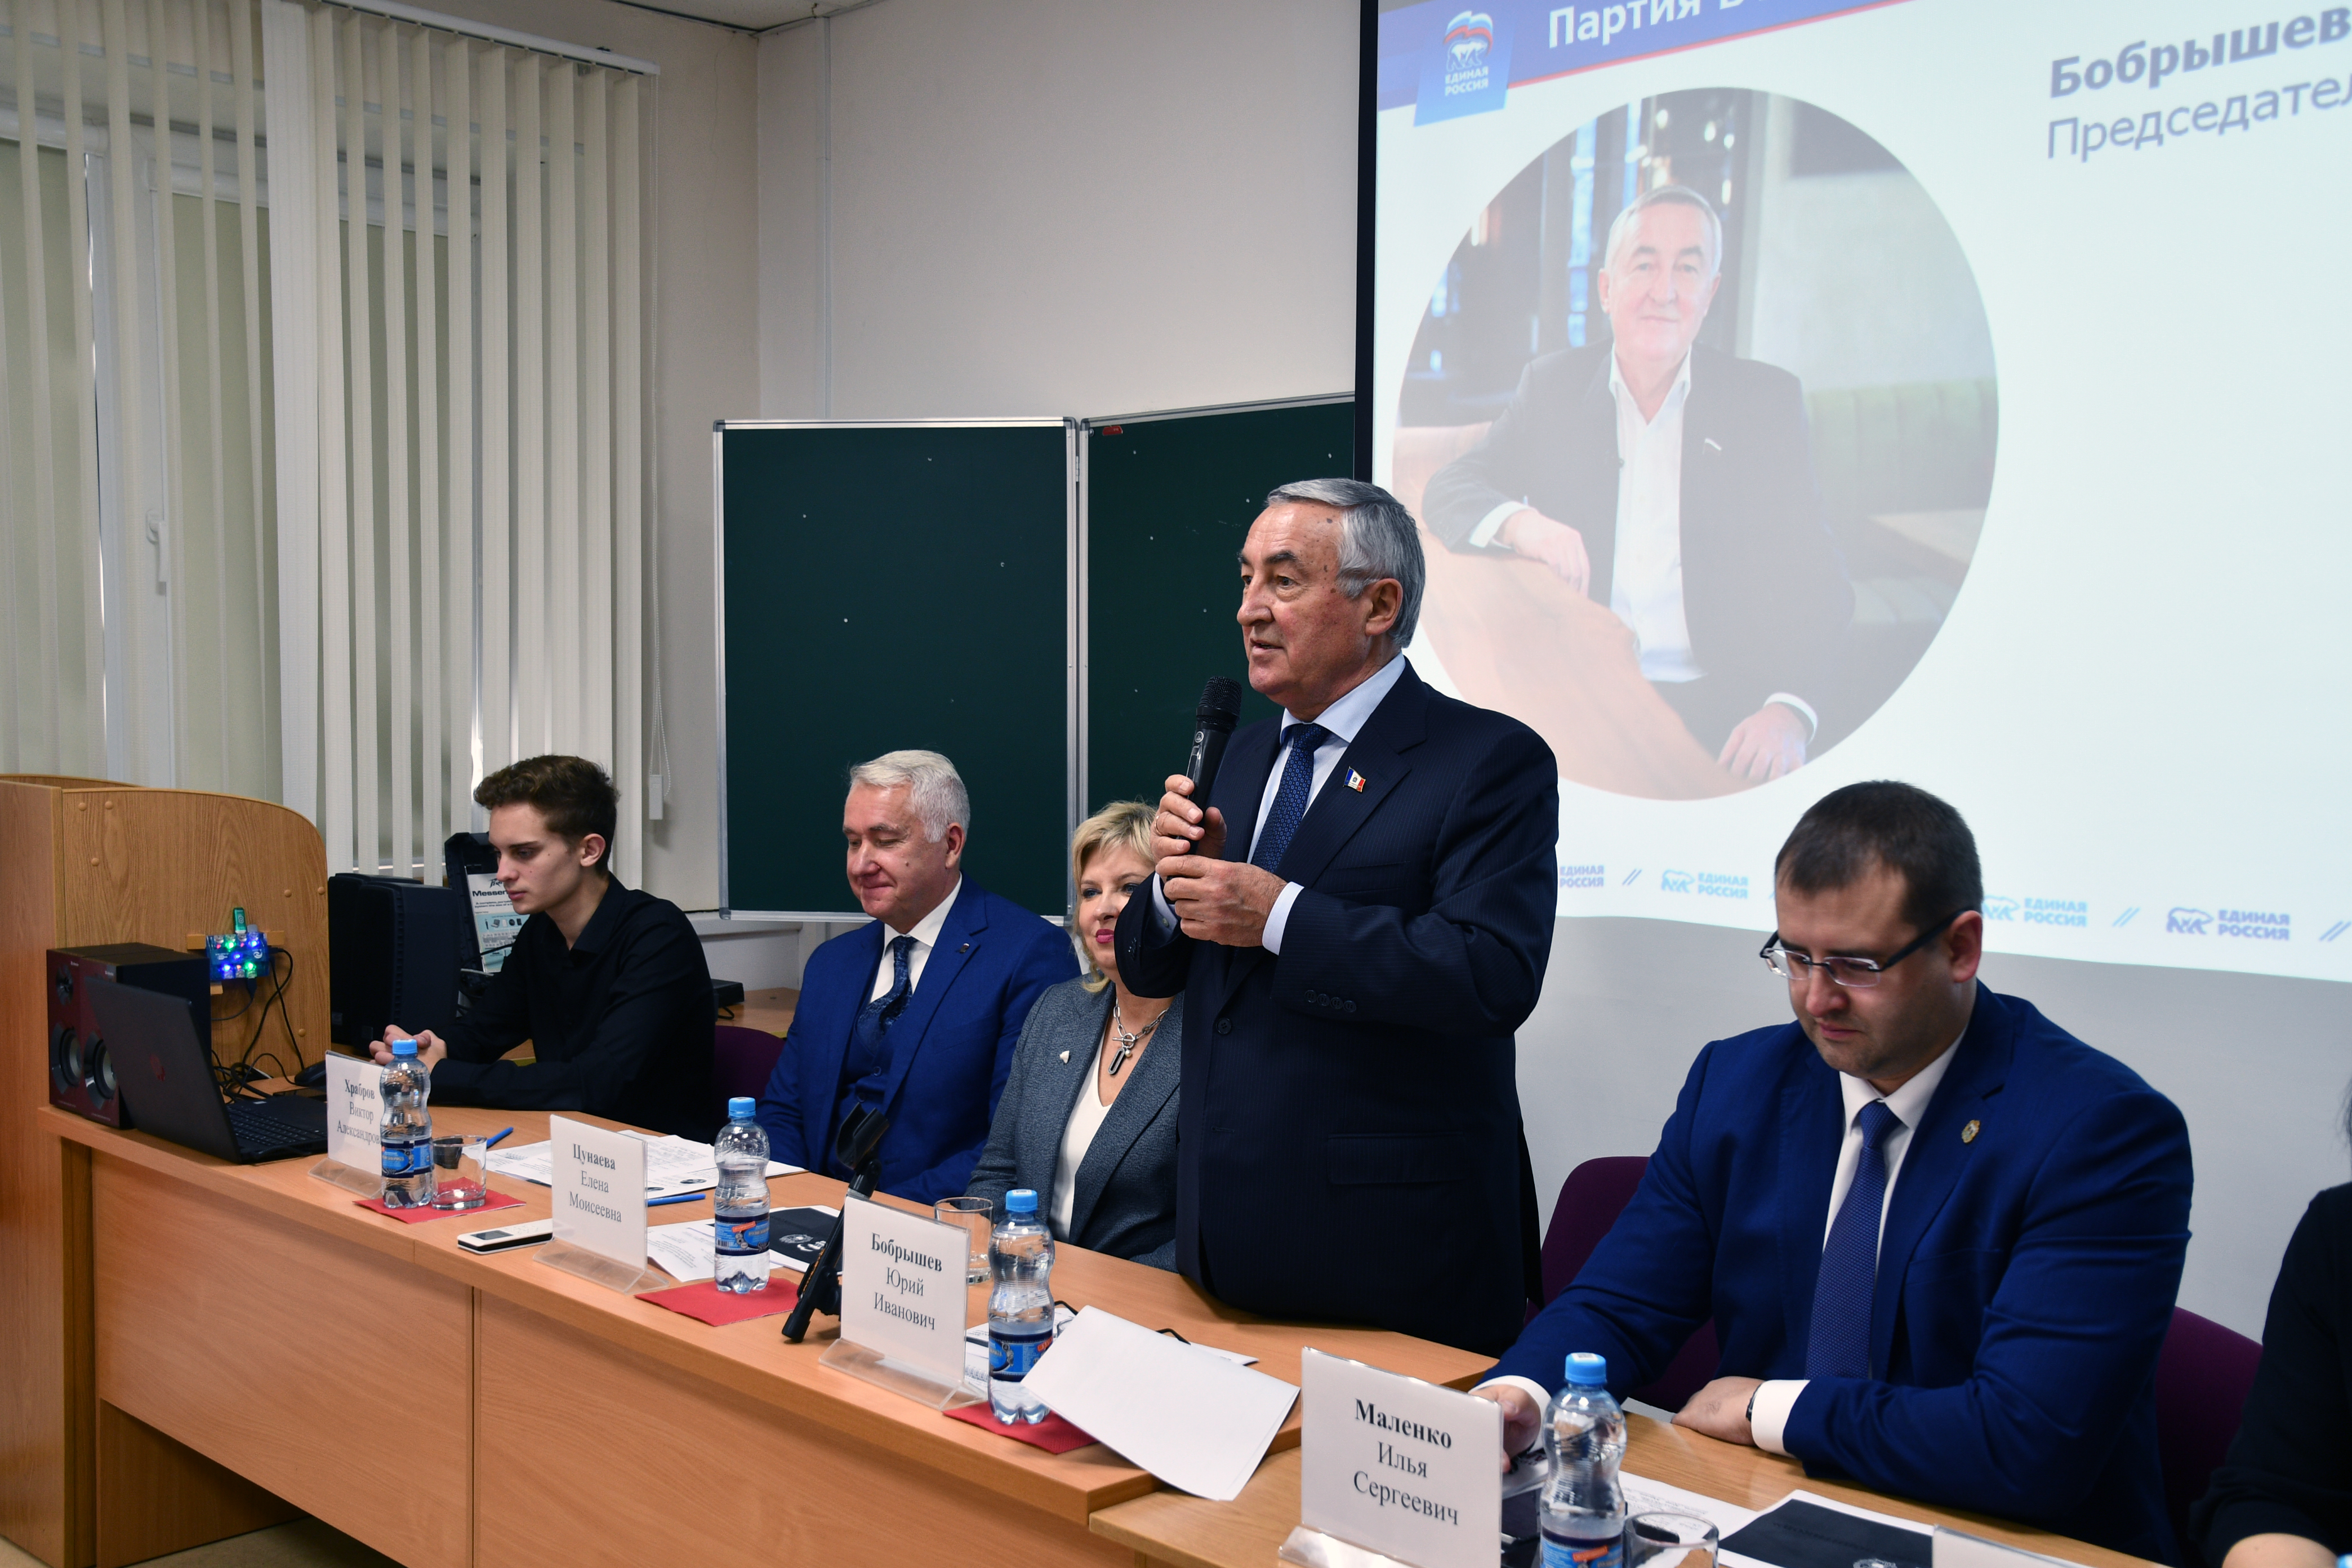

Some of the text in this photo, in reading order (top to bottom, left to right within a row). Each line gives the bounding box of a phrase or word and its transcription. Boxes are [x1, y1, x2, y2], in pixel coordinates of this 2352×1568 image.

[1549, 0, 1700, 48] Партия
[2050, 7, 2351, 98] Бобрышев
[1445, 66, 1489, 84] ЕДИНАЯ
[1445, 78, 1489, 96] РОССИЯ
[1560, 865, 1604, 876] ЕДИНАЯ
[1560, 876, 1604, 888] РОССИЯ
[1698, 872, 1749, 886] ЕДИНАЯ
[1698, 884, 1749, 899] РОССИЯ
[2024, 898, 2087, 913] ЕДИНАЯ
[2219, 909, 2290, 925] ЕДИНАЯ
[2024, 911, 2087, 927] РОССИЯ
[2218, 924, 2290, 941] РОССИЯ
[345, 1079, 375, 1100] Храбров
[349, 1101, 373, 1124] Виктор
[573, 1143, 616, 1170] Цунаева
[581, 1170, 609, 1193] Елена
[569, 1191, 622, 1223] Моисеевна
[871, 1232, 942, 1272] Бобрышев
[886, 1267, 924, 1296] Юрий
[874, 1293, 936, 1330] Иванович
[1355, 1398, 1451, 1449] Маленко
[1378, 1441, 1427, 1478] Илья
[1353, 1471, 1458, 1525] Сергеевич
